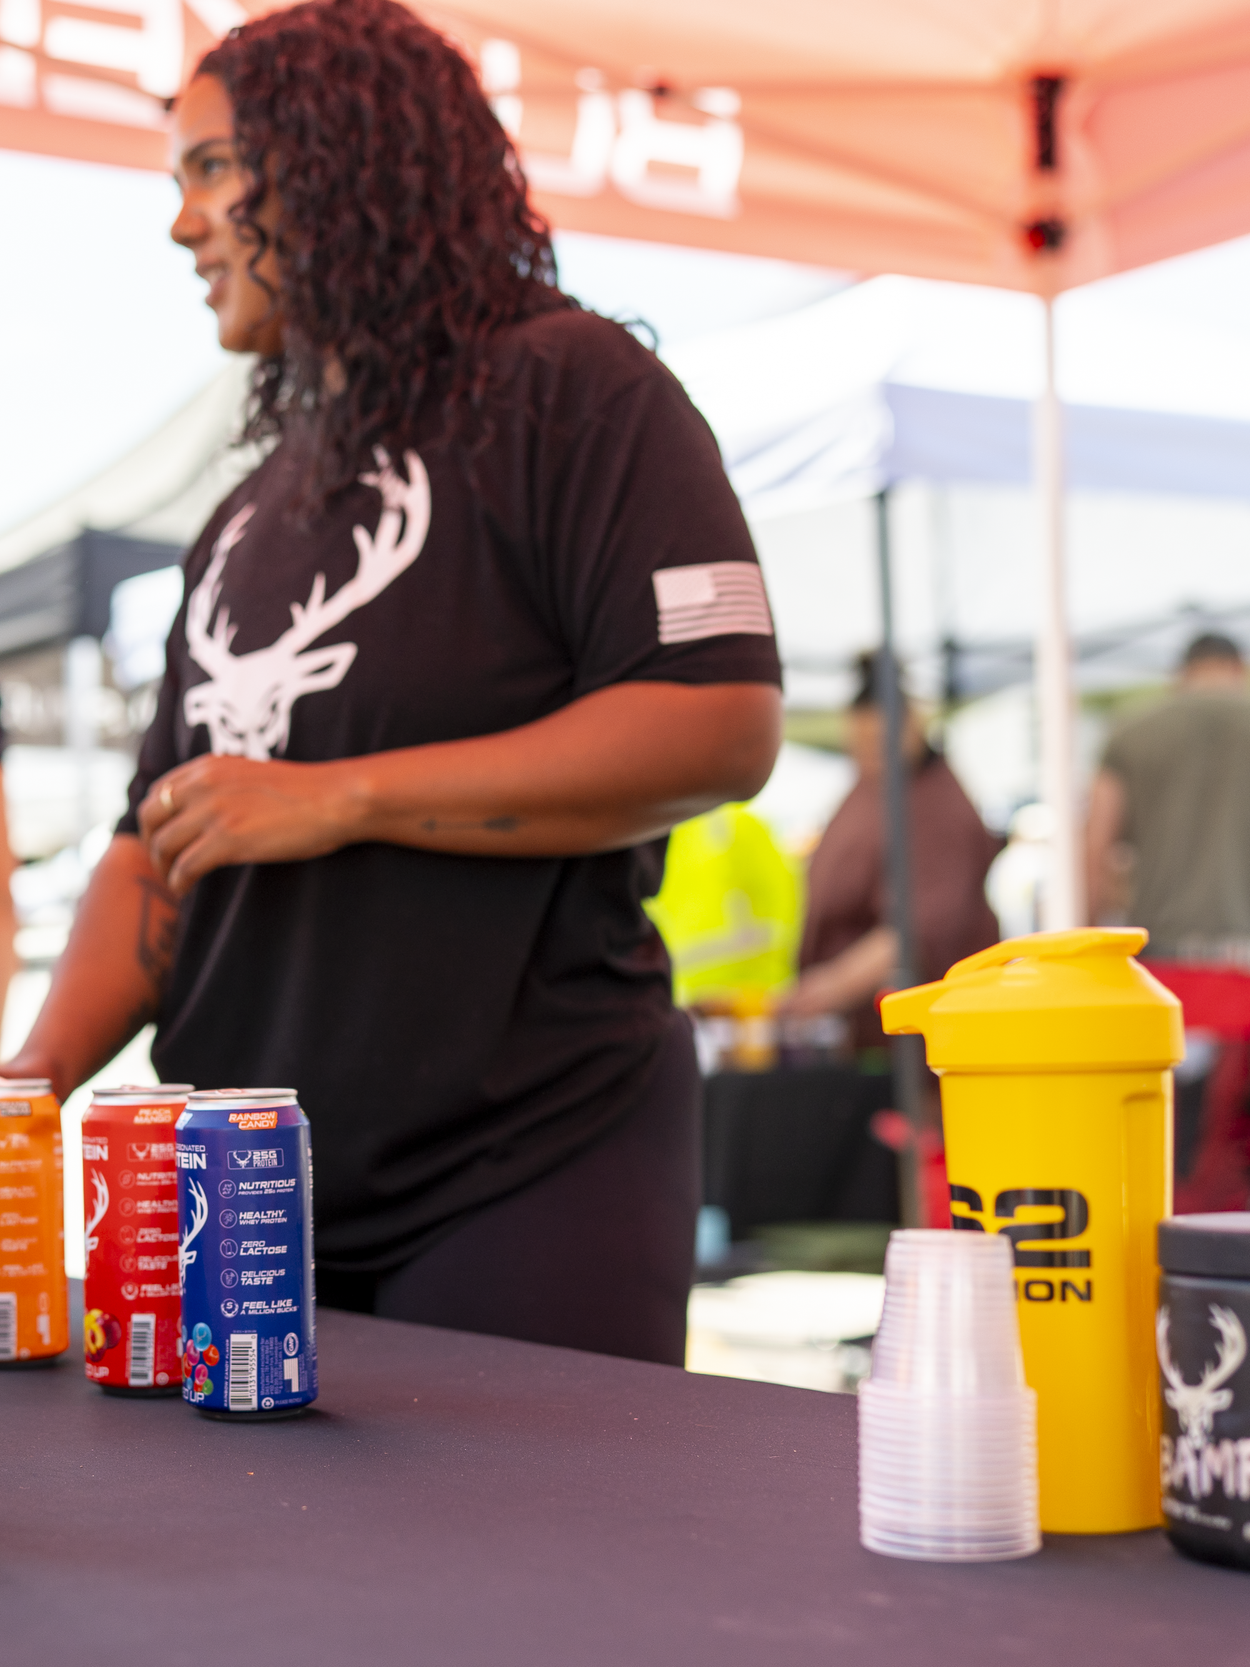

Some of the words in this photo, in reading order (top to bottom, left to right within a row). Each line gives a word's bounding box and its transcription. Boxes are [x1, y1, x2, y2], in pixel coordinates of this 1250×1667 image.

[229, 1112, 276, 1121] RAINBOW
[238, 1120, 275, 1129] CANDY
[252, 1150, 277, 1160] 25G
[253, 1159, 277, 1167] PROTEIN
[238, 1179, 296, 1190] NUTRITIOUS
[238, 1209, 285, 1220] HEALTHY
[241, 1240, 266, 1248] ZERO
[239, 1245, 288, 1256] LACTOSE
[240, 1269, 286, 1278] DELICIOUS
[240, 1277, 273, 1285] TASTE
[242, 1301, 269, 1309] FEEL
[271, 1299, 293, 1308] LIKE
[190, 1390, 205, 1404] UP
